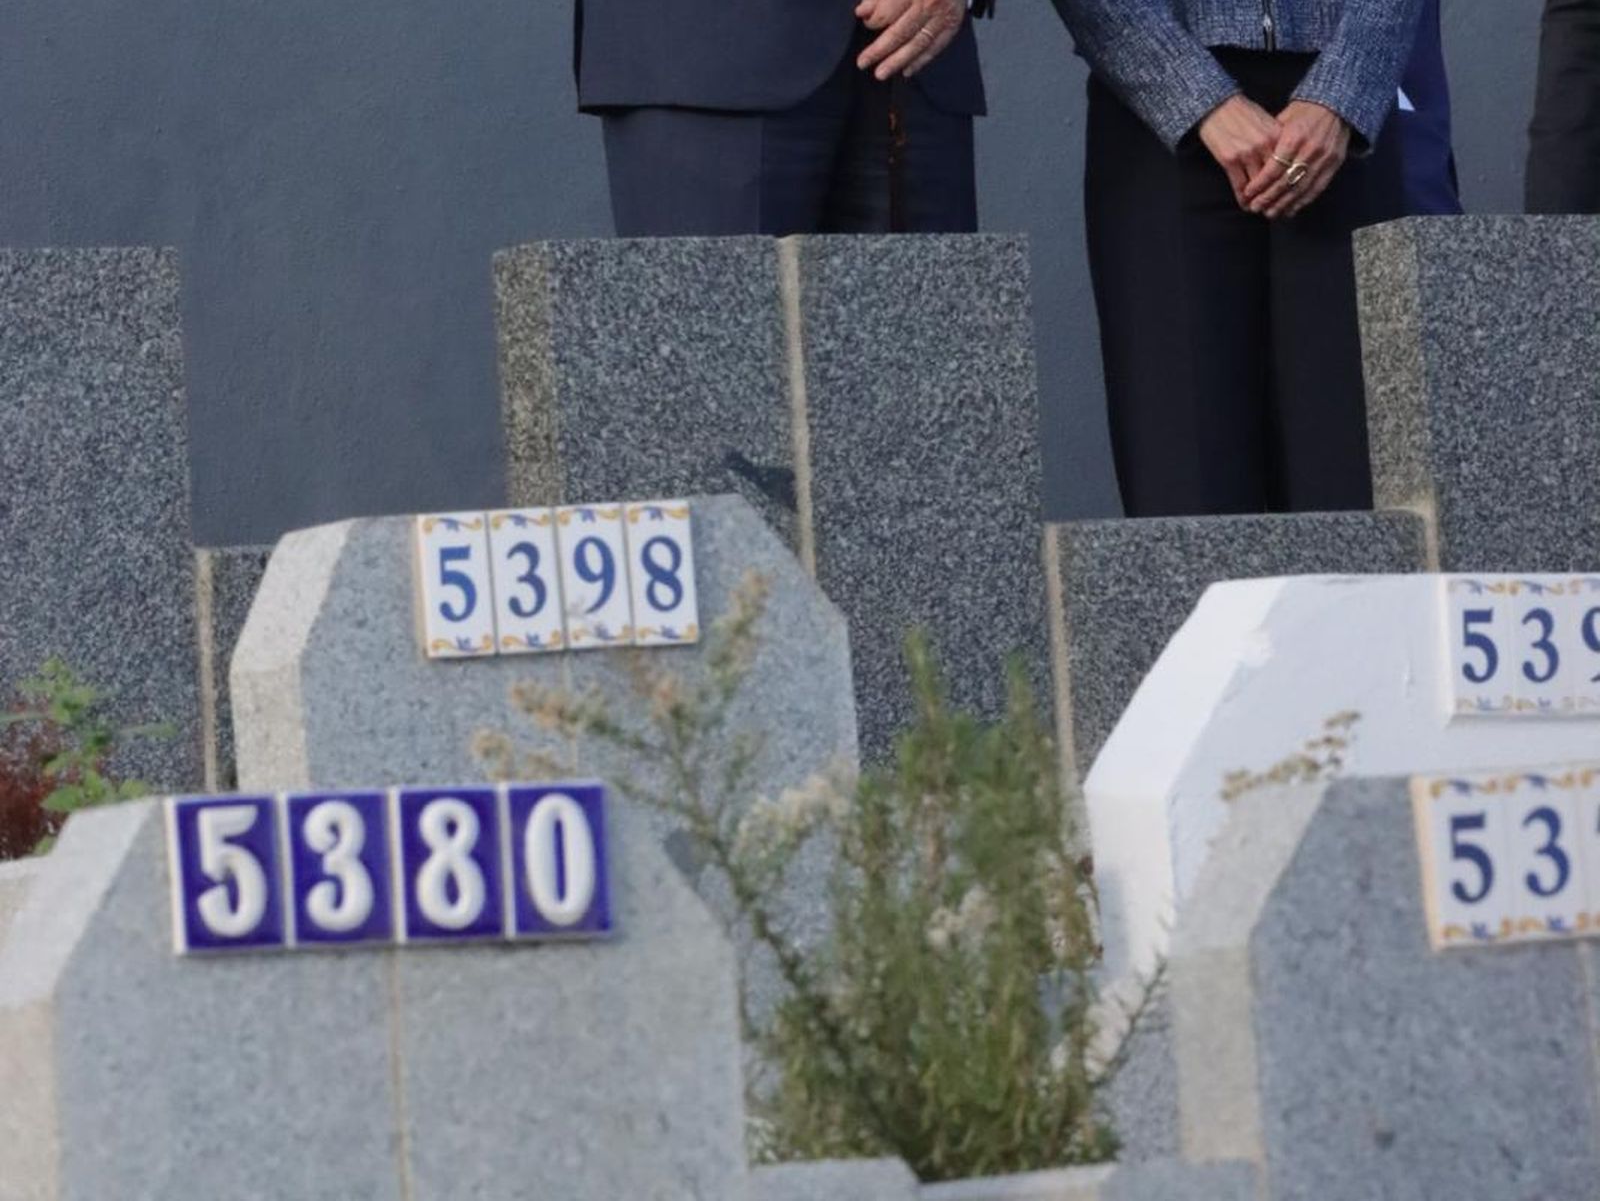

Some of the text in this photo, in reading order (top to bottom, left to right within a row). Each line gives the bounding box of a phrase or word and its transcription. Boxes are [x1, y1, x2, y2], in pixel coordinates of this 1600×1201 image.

[438, 534, 685, 623] 5398
[197, 792, 596, 938] 5380
[1449, 805, 1600, 904] 53
